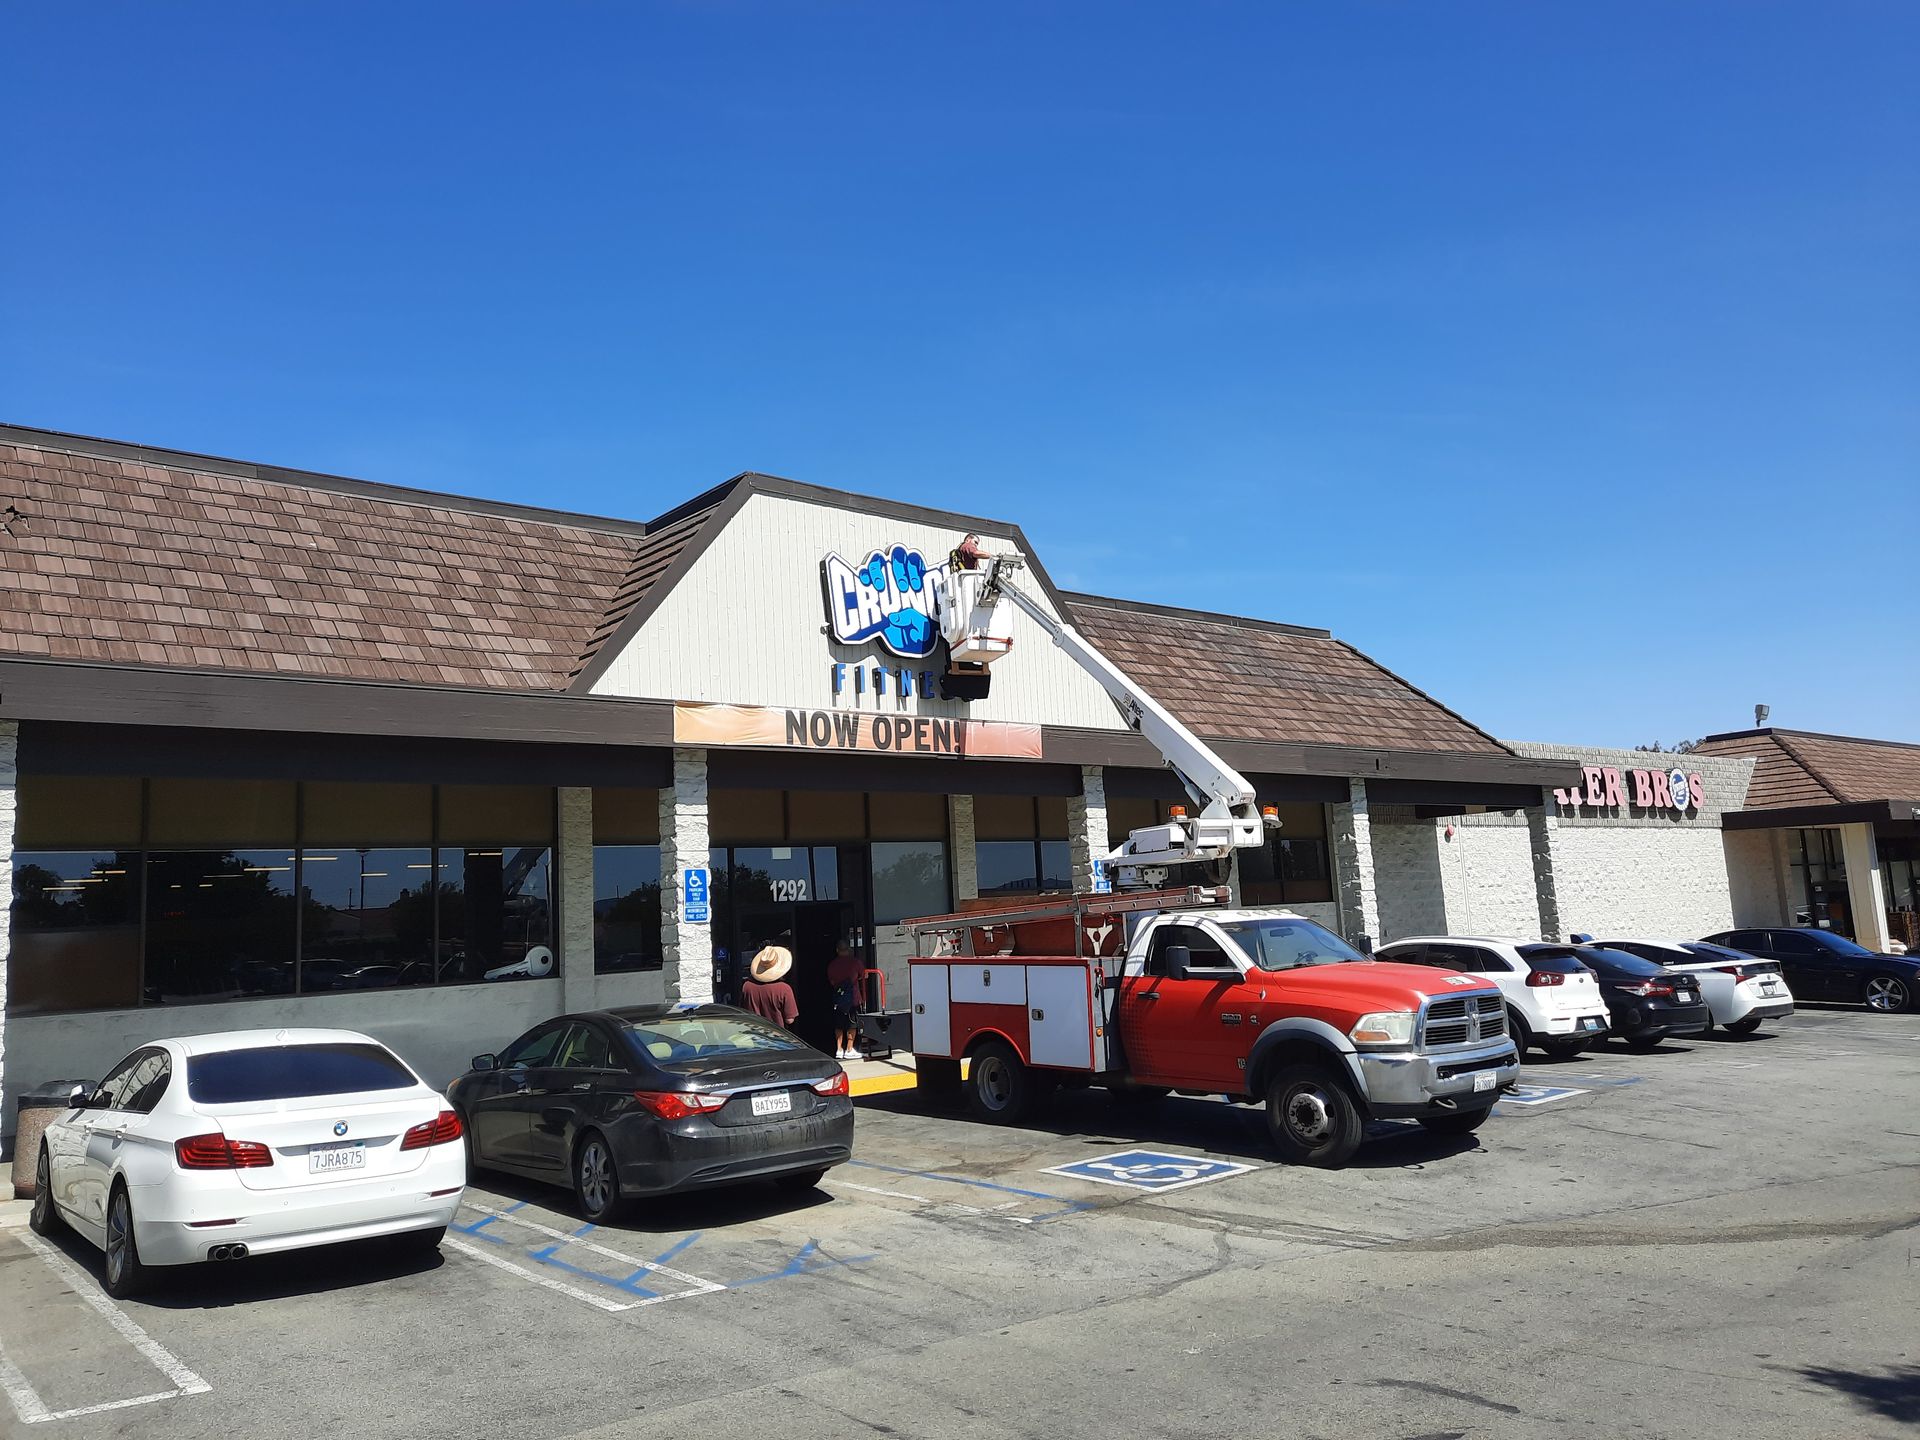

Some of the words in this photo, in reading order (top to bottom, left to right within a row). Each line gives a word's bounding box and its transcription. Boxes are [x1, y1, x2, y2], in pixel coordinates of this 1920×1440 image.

[785, 710, 859, 748] NOW
[872, 716, 961, 753] OPEN!
[770, 880, 806, 902] 1292
[755, 1098, 789, 1112] 8AIY955
[313, 1151, 362, 1168] 7JRA875
